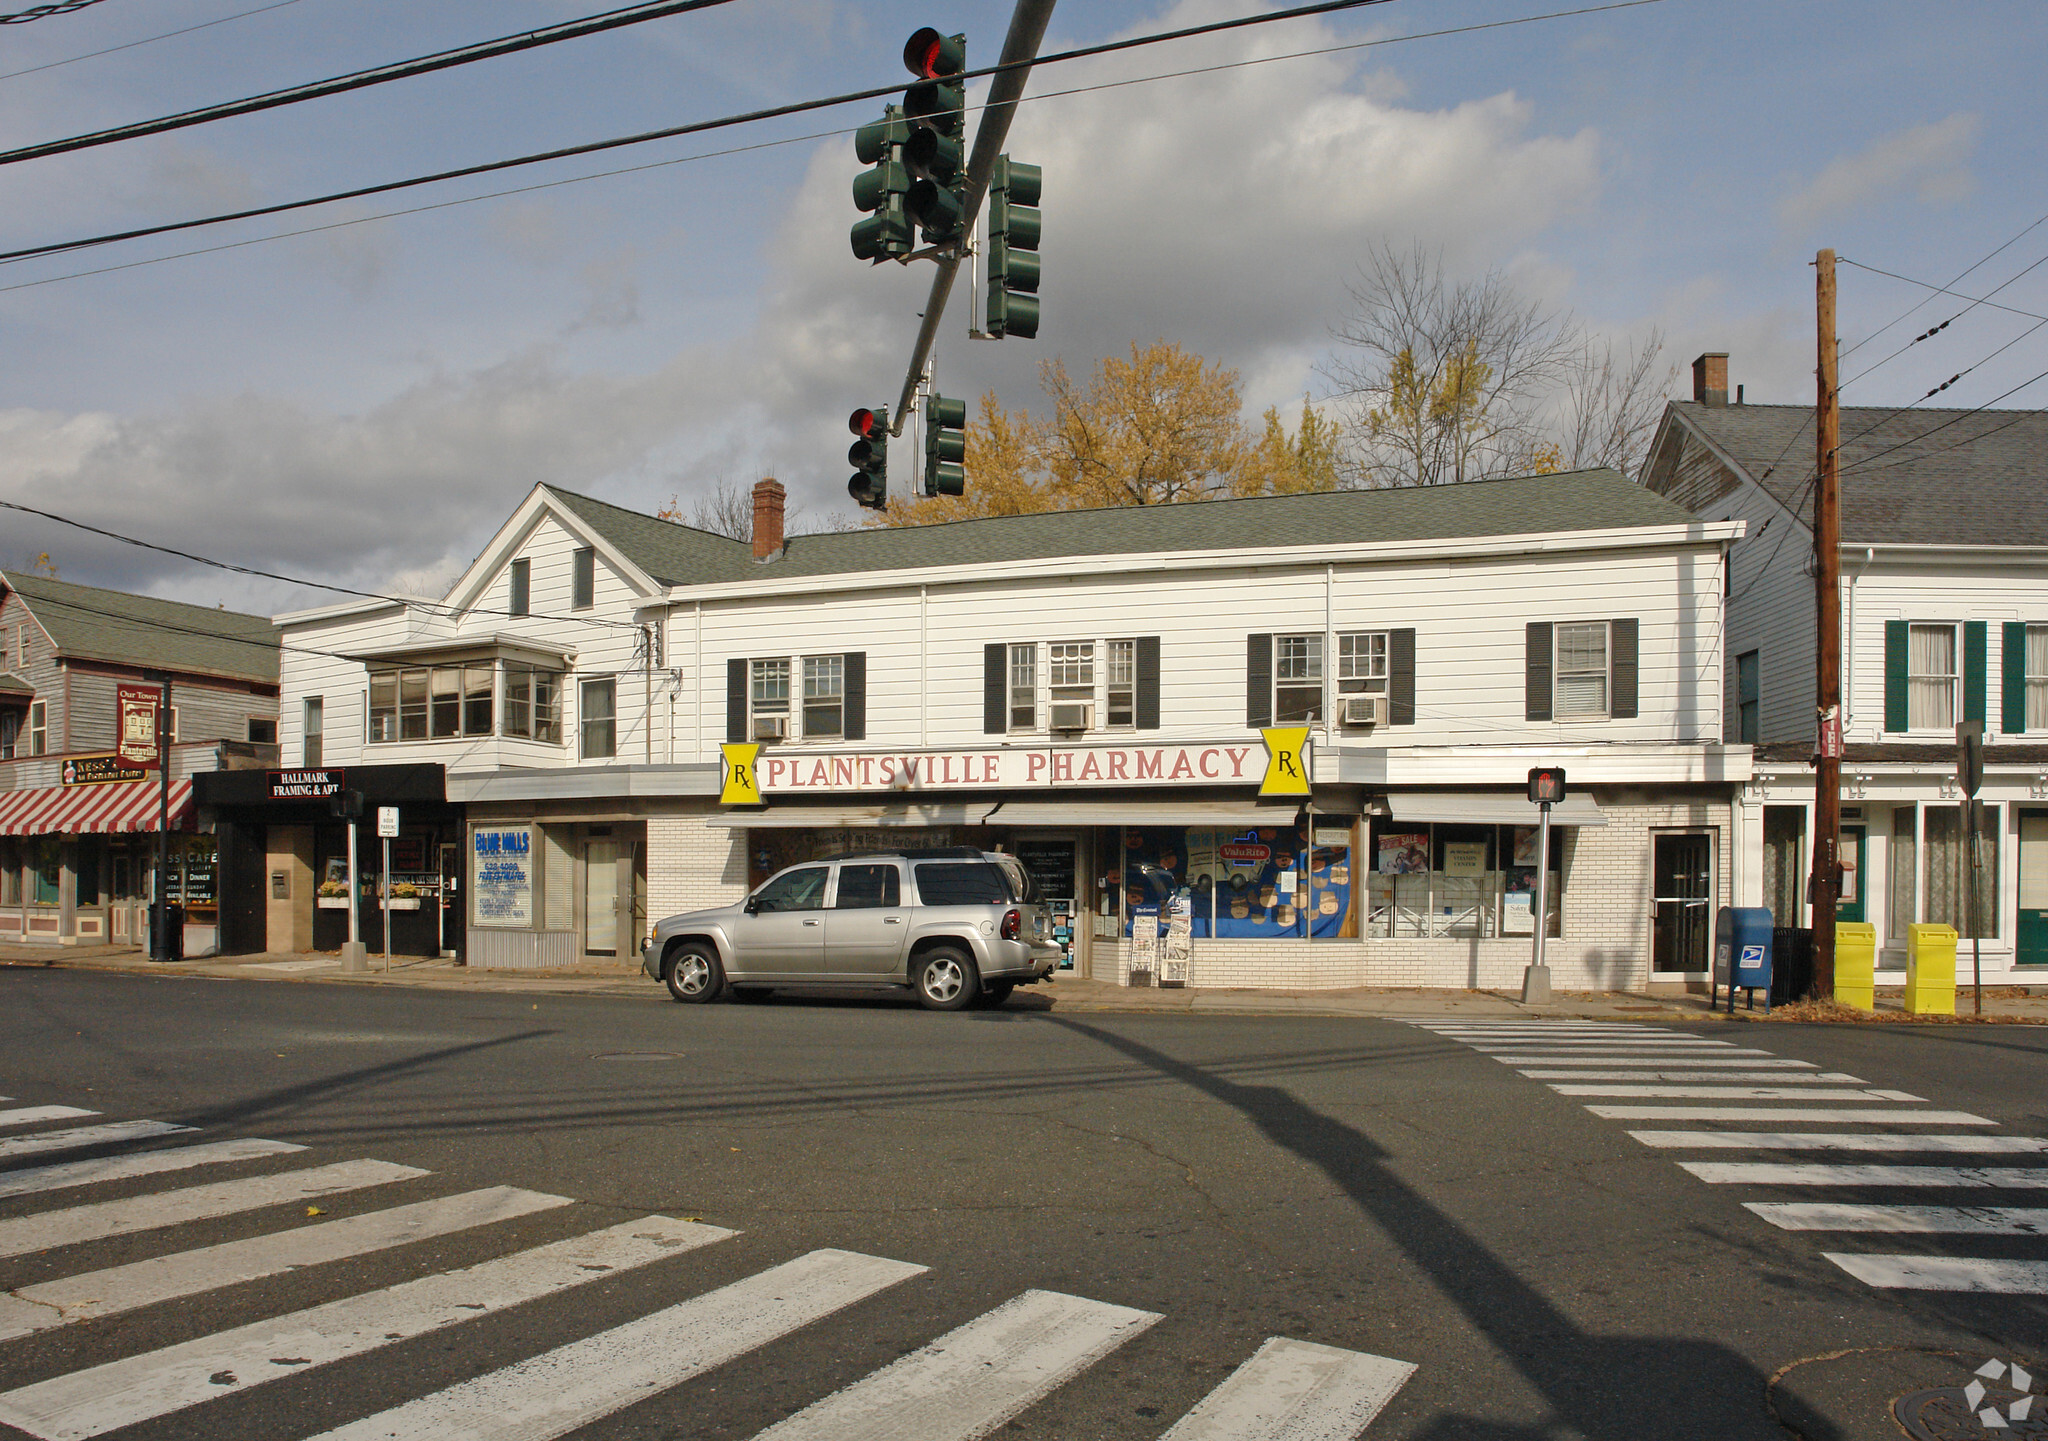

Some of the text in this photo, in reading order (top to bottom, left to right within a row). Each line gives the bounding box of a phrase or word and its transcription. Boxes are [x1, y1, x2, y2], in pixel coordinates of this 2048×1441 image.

[120, 690, 158, 700] Our Town
[120, 745, 158, 757] Plantsville
[767, 748, 1251, 787] PLANTSVILLE PHARMACY
[281, 772, 329, 784] HALLMARK
[273, 784, 339, 796] FRAMING & ART
[386, 808, 391, 816] 2
[475, 833, 500, 851] BLUE
[1401, 834, 1418, 845] SALE
[1224, 847, 1266, 857] ValuRite
[187, 891, 212, 899] AVAILABLE
[1510, 904, 1527, 912] Safety
